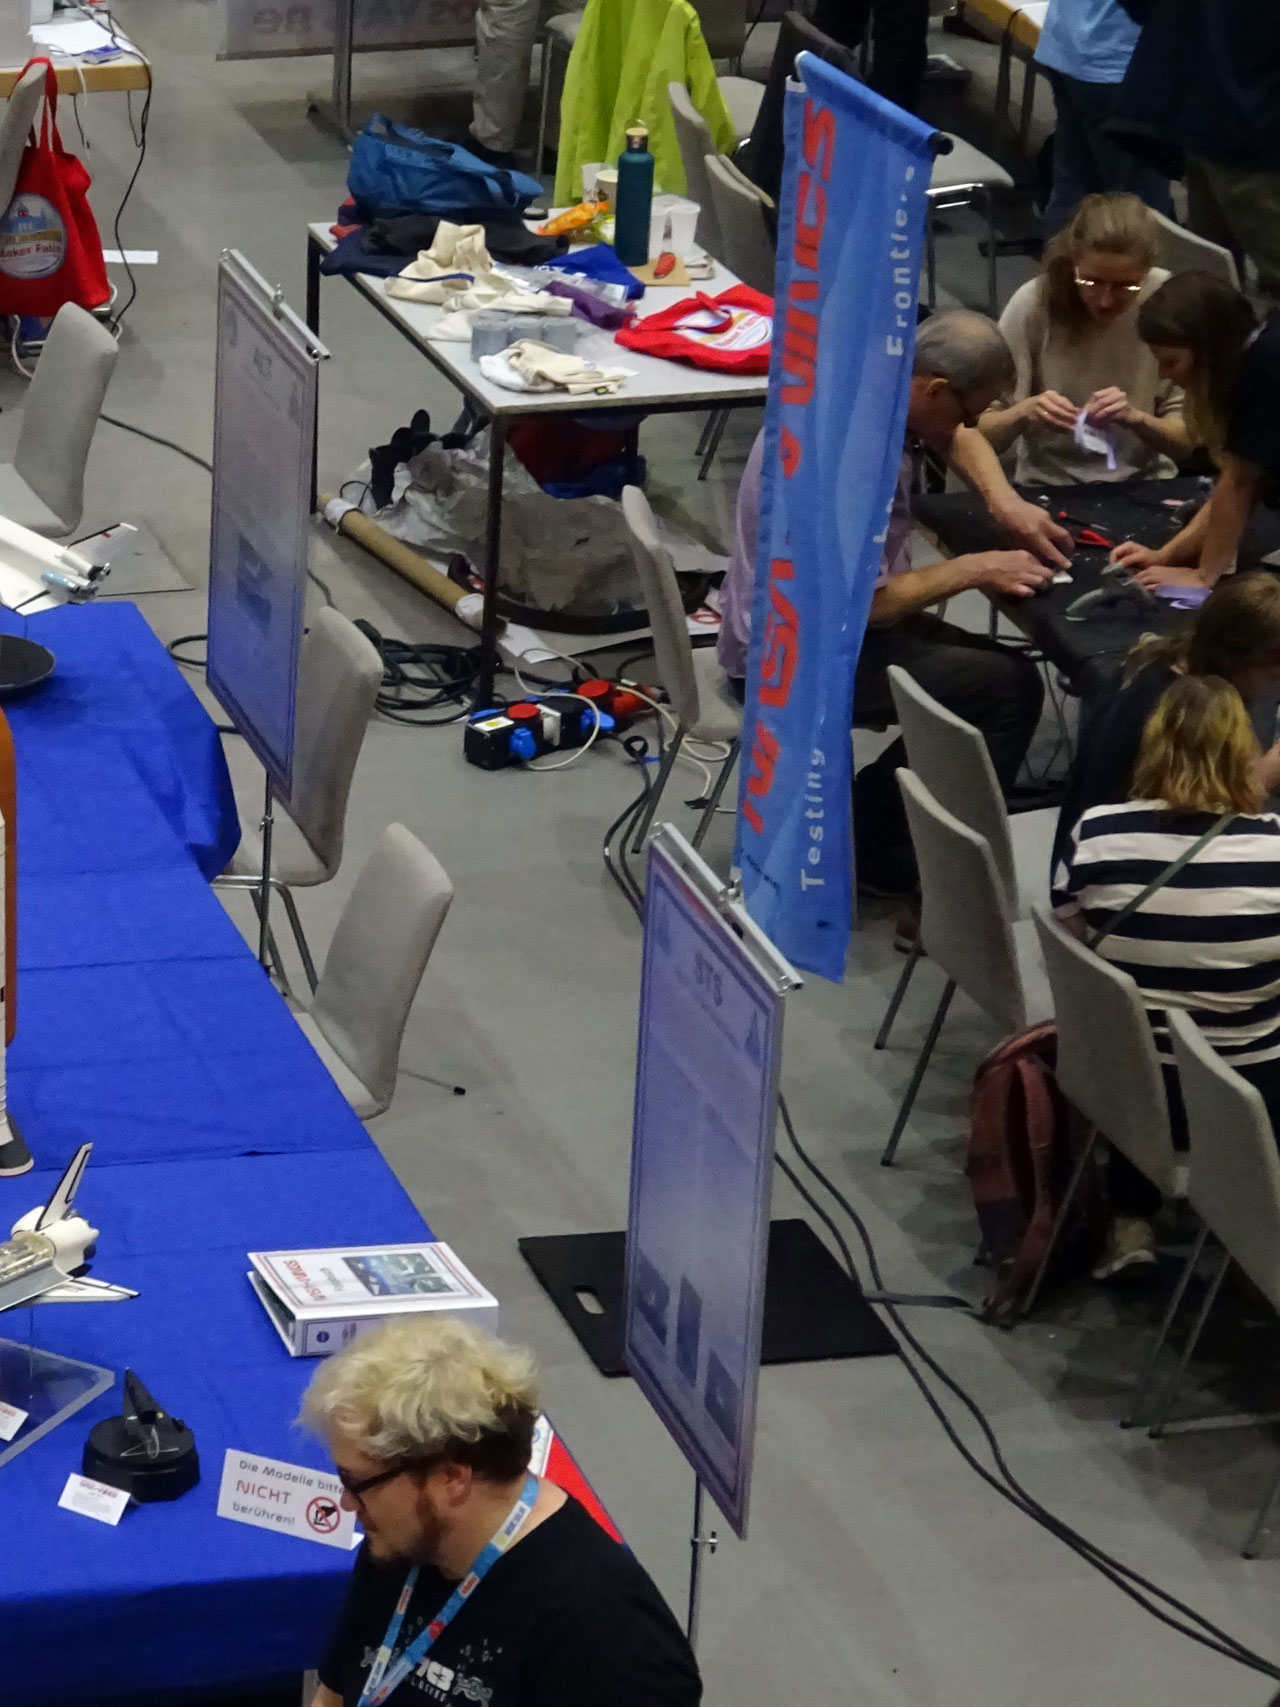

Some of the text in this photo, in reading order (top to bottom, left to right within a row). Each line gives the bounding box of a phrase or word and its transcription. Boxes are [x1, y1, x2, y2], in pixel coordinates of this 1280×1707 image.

[238, 1459, 259, 1473] Die
[262, 1465, 314, 1488] Modelle
[235, 1479, 292, 1505] NICHT
[232, 1501, 296, 1526] berühren!
